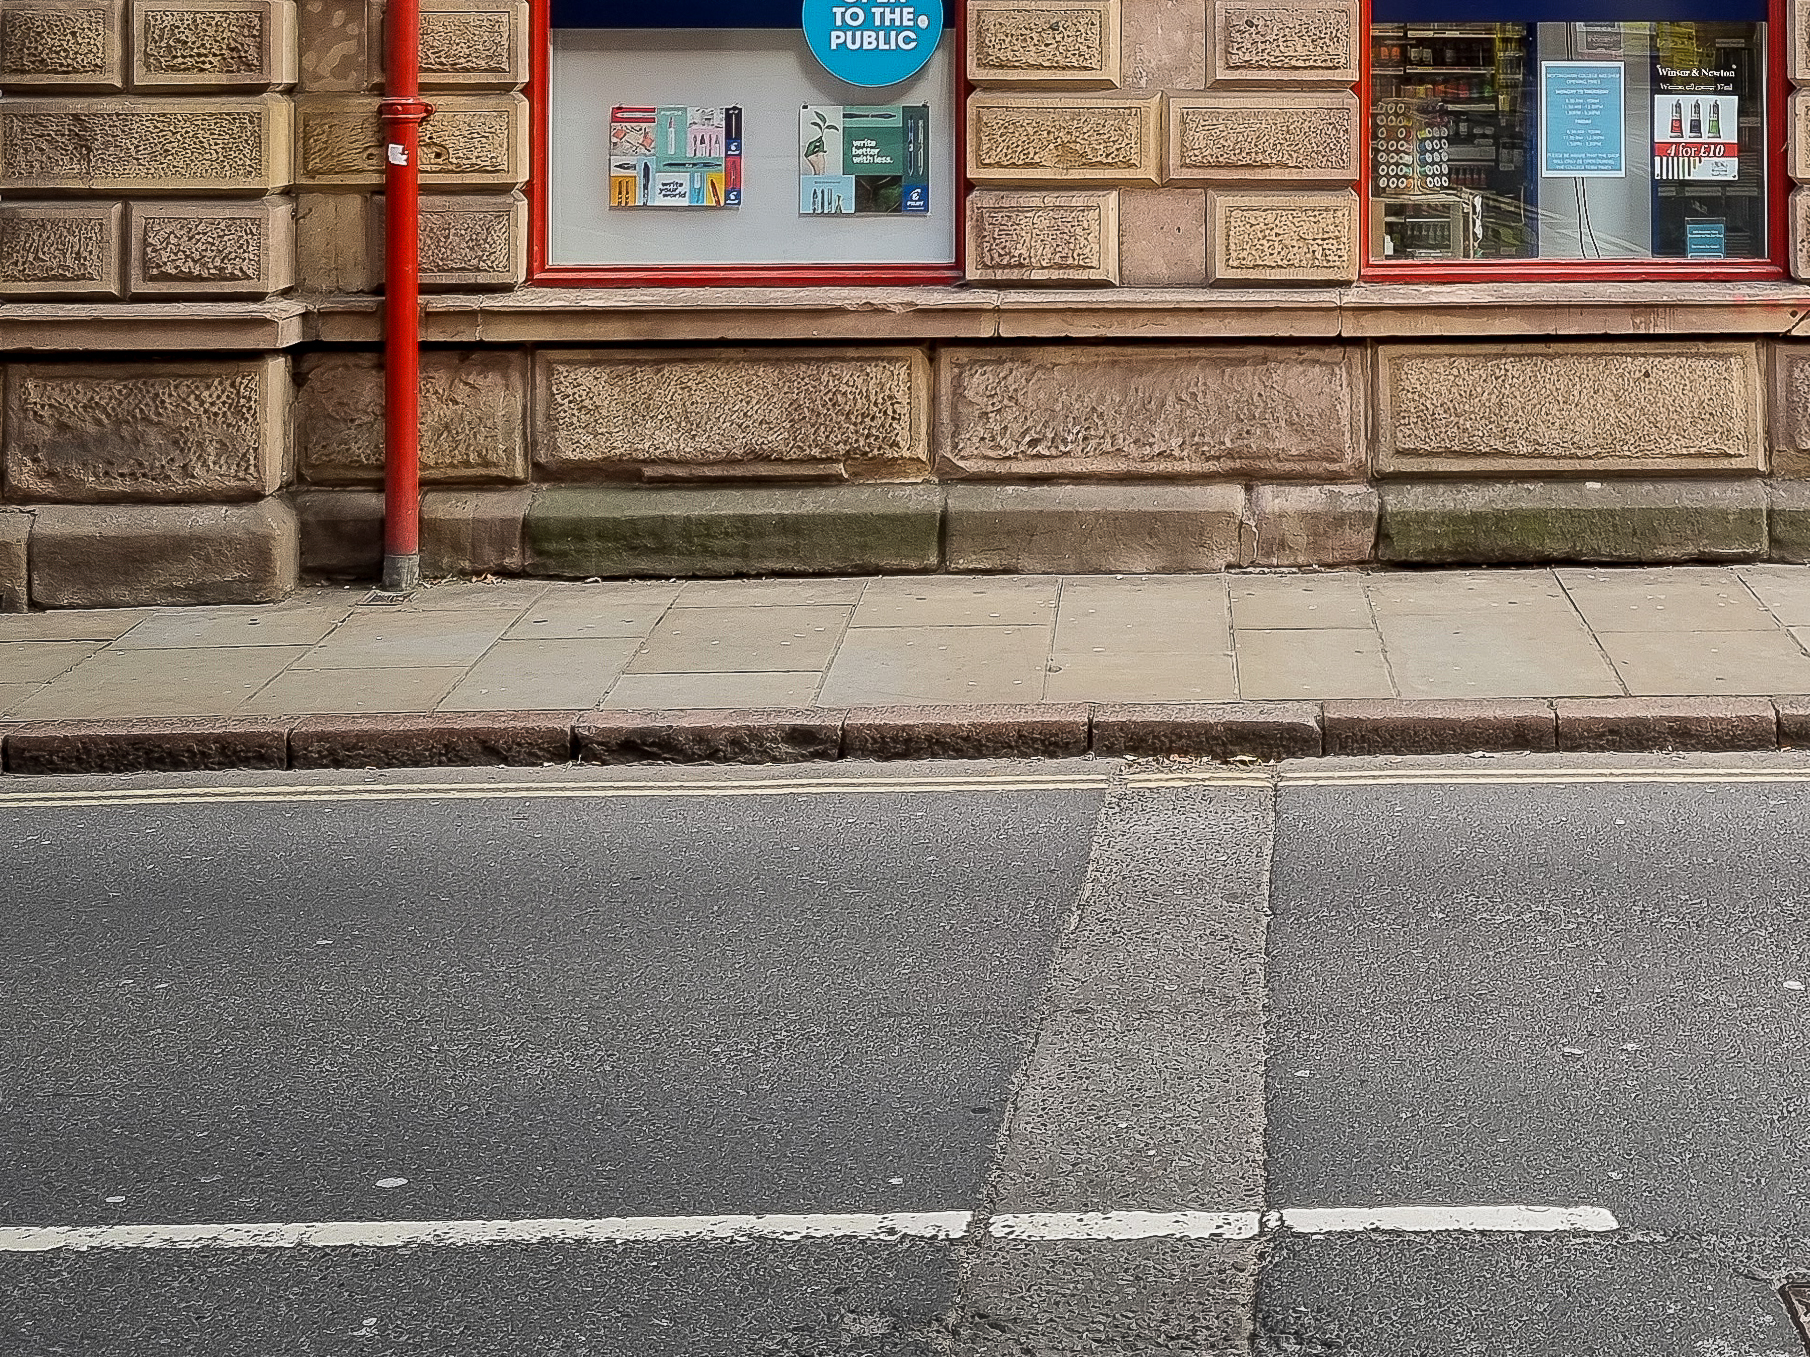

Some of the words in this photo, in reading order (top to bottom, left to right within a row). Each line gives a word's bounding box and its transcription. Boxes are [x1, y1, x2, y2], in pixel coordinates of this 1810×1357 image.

[832, 7, 865, 27] TO
[830, 30, 918, 50] PUBLIC
[1691, 67, 1700, 77] &
[1701, 67, 1735, 78] Newton
[852, 139, 877, 148] write
[852, 147, 880, 156] better
[1666, 144, 1677, 157] 4
[1679, 143, 1698, 157] for
[1698, 144, 1725, 157] £10
[852, 155, 873, 164] with
[874, 155, 894, 164] less.
[658, 186, 679, 195] your
[662, 190, 687, 199] world
